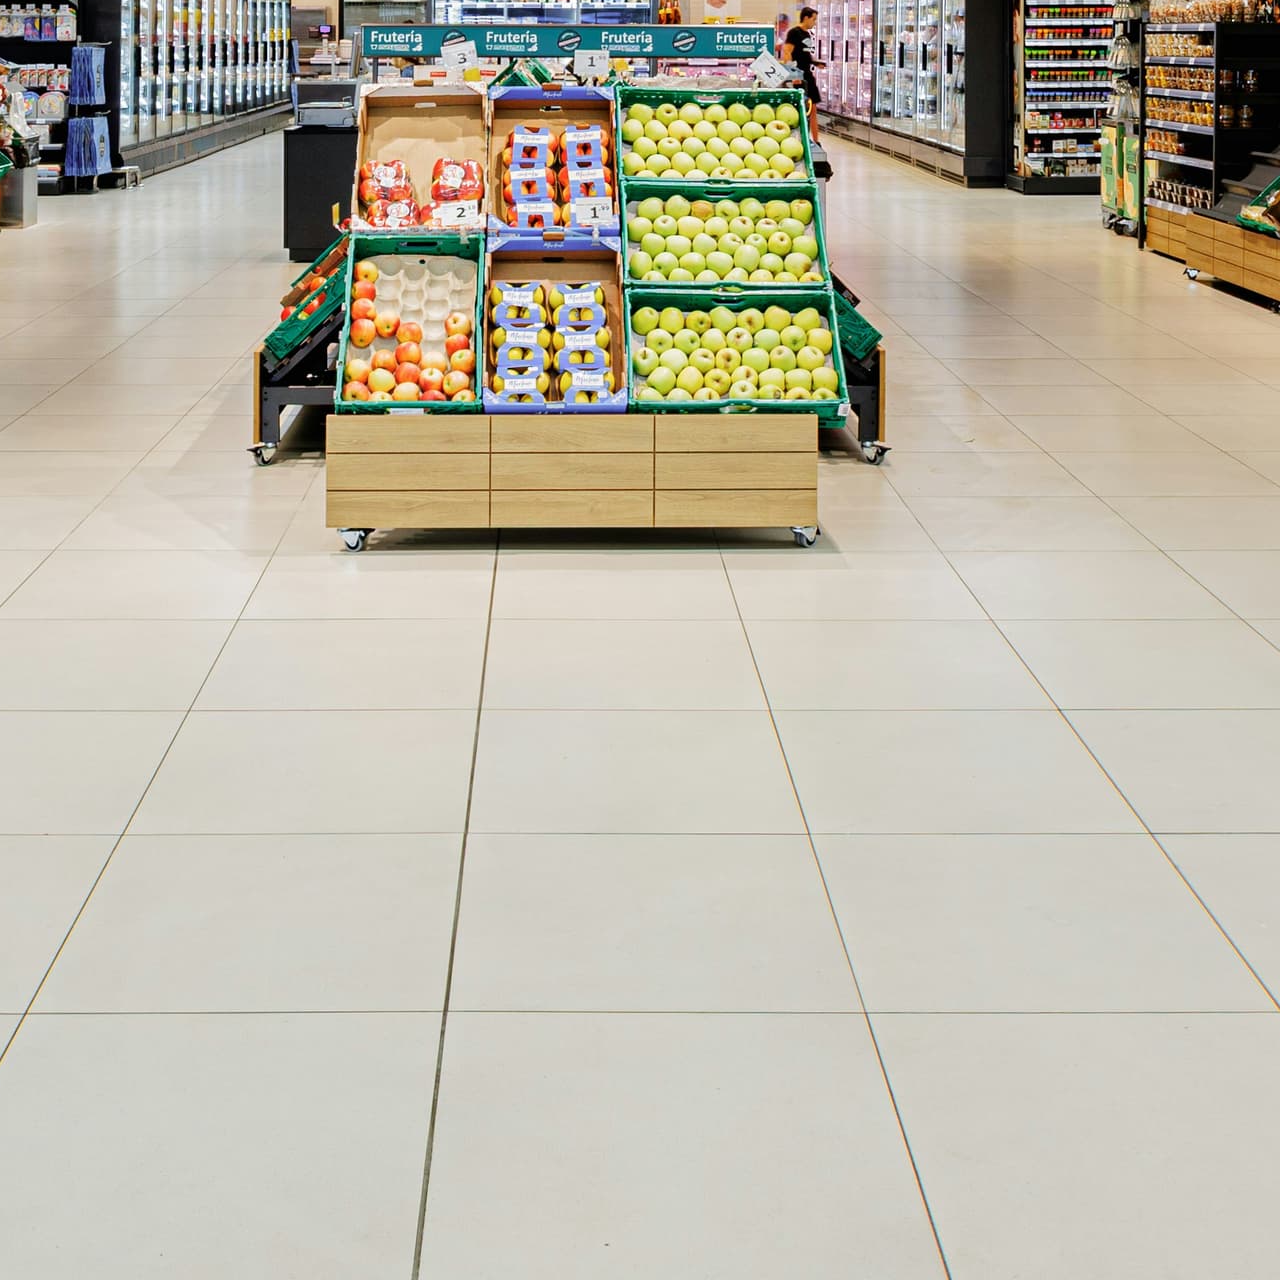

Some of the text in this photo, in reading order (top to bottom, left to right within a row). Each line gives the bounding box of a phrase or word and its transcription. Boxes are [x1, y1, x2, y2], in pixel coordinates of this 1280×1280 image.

[371, 30, 423, 43] Frutería
[486, 30, 538, 43] Frutería
[601, 31, 652, 44] Frutería
[716, 31, 767, 44] Frutería
